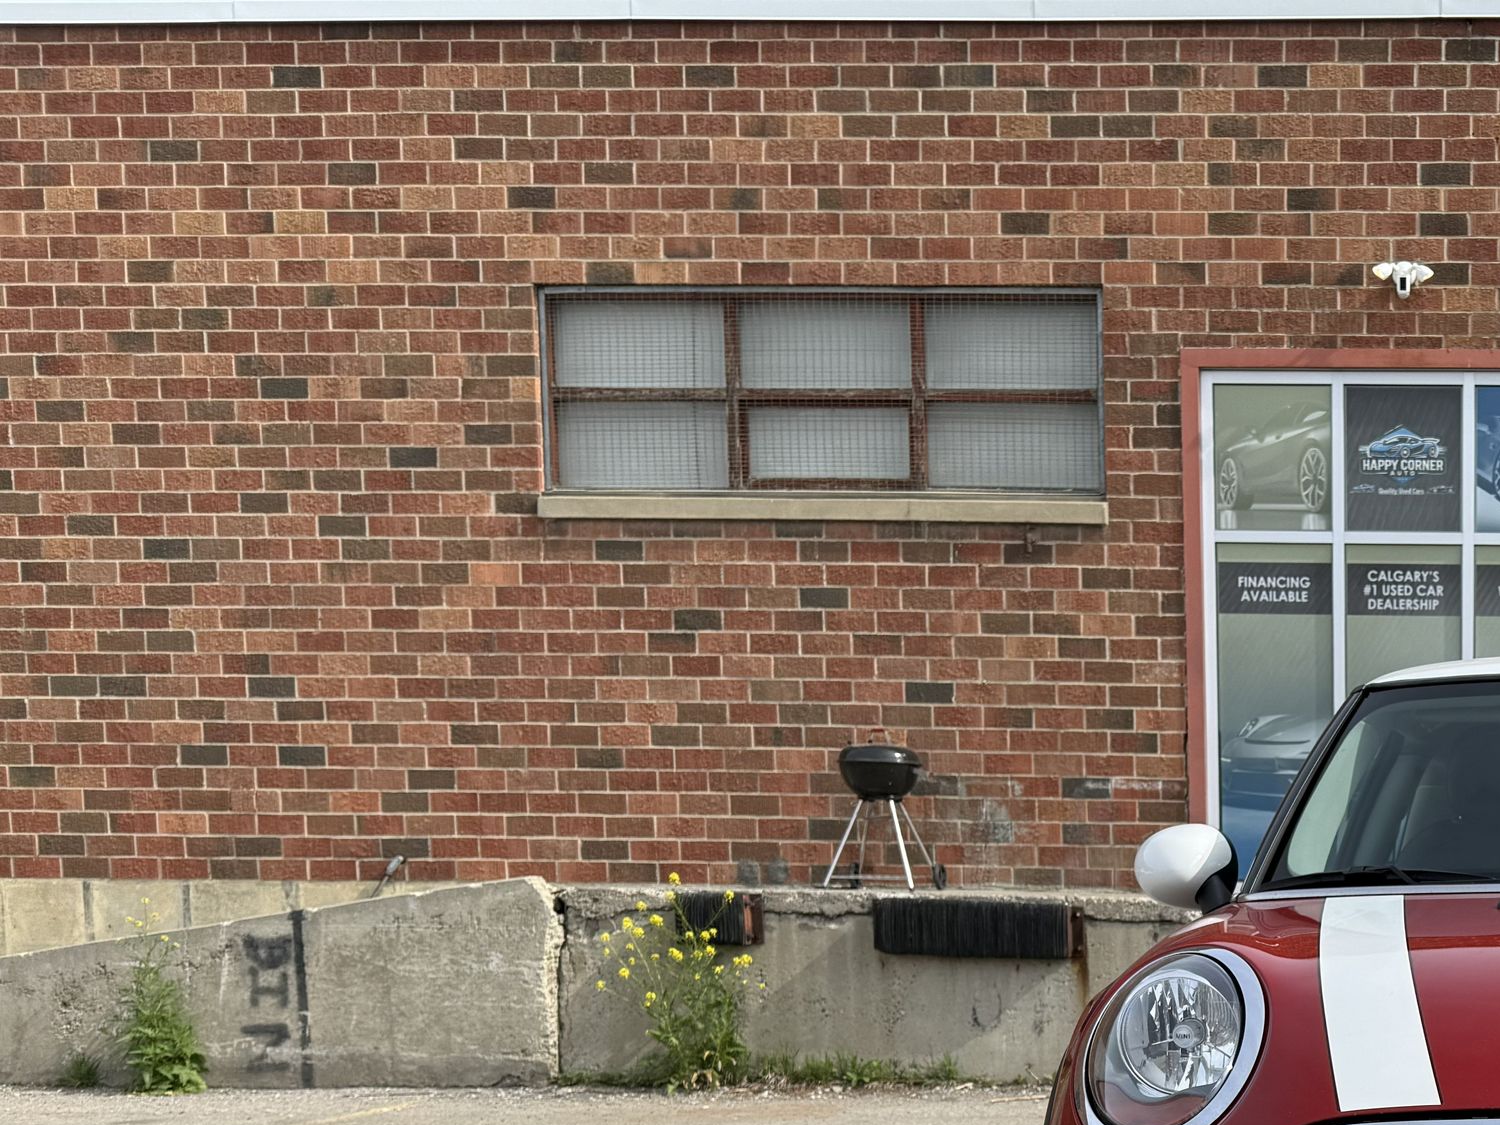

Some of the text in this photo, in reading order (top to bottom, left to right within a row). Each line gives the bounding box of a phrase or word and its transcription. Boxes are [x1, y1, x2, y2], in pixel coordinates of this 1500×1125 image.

[1362, 459, 1443, 471] HAPPY CORNER
[1237, 576, 1311, 589] FINANCING
[1367, 570, 1440, 582] CALGARY'S
[1240, 590, 1309, 603] AVAILABLE
[1363, 584, 1444, 597] #1 USED CAR
[1367, 598, 1440, 611] DEALERSHIP
